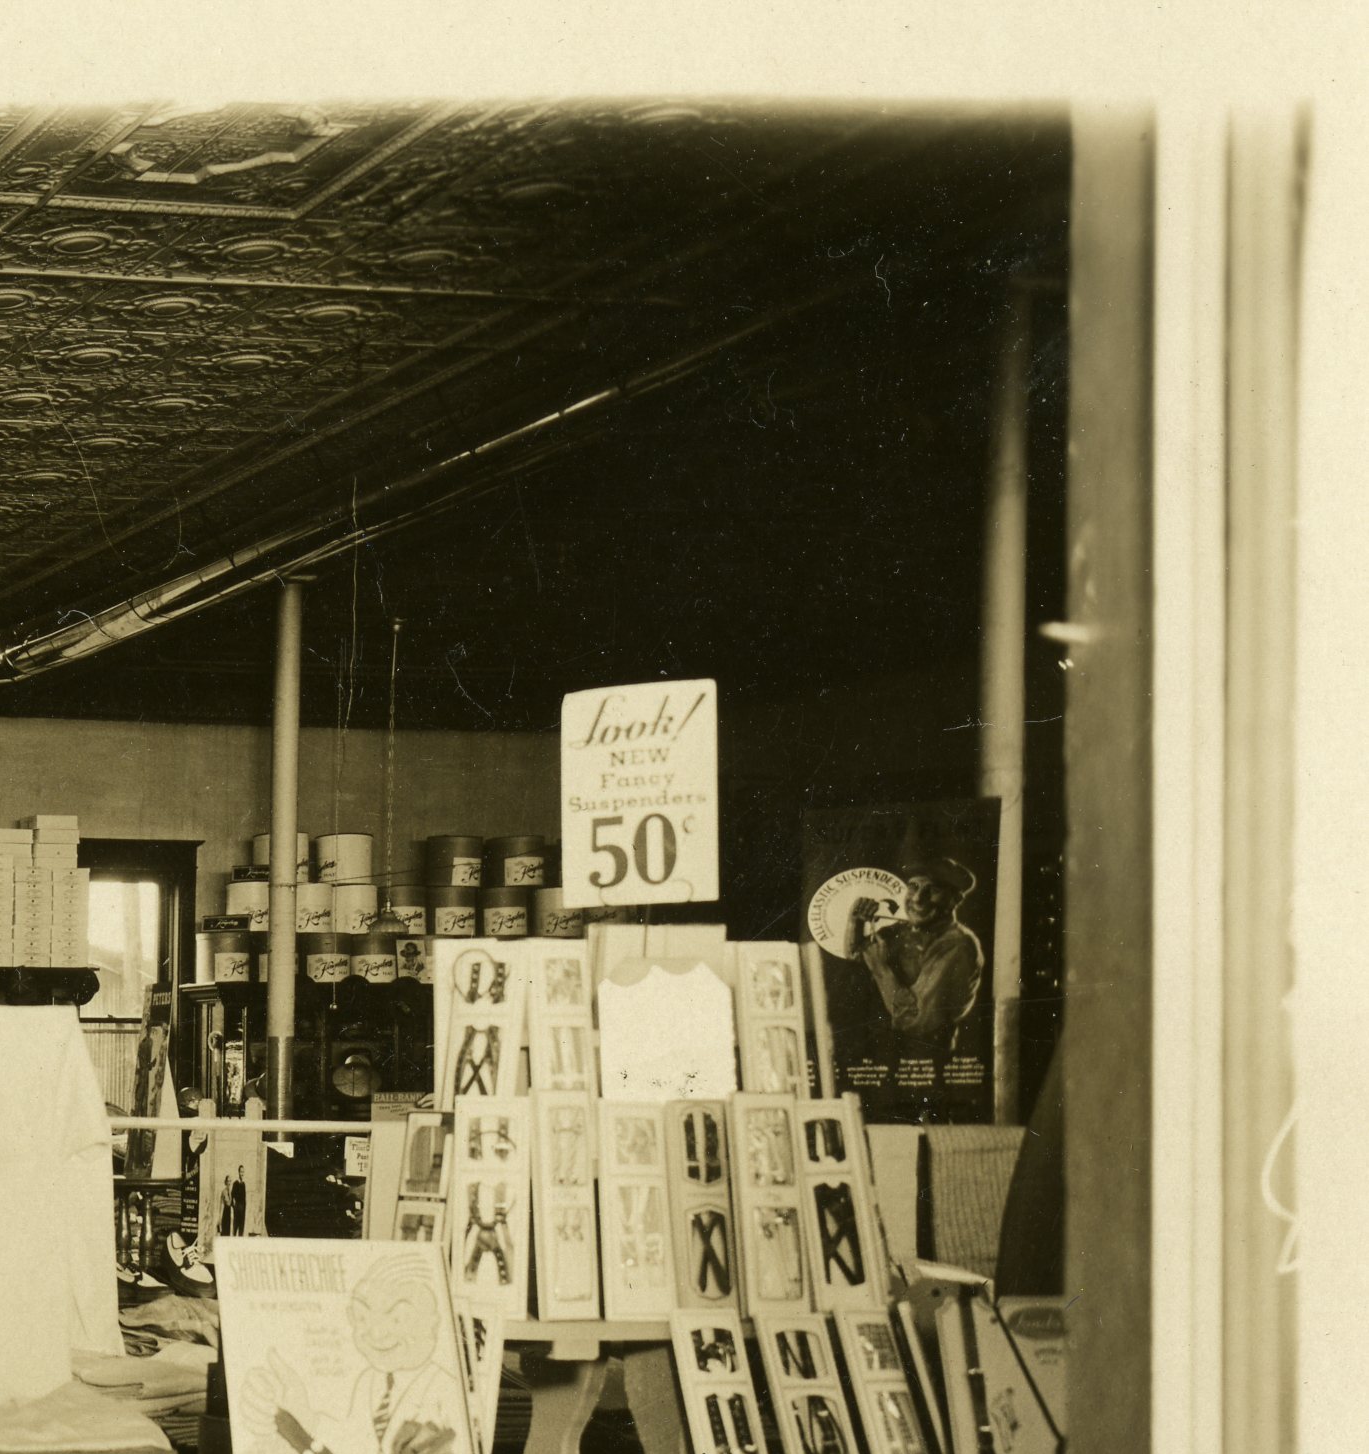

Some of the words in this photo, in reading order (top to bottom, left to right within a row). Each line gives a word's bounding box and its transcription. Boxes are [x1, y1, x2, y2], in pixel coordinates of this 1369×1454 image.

[610, 748, 672, 767] NEW
[600, 773, 676, 790] Fancy
[568, 791, 707, 813] Suspenders
[836, 869, 903, 894] SUSPENDERS
